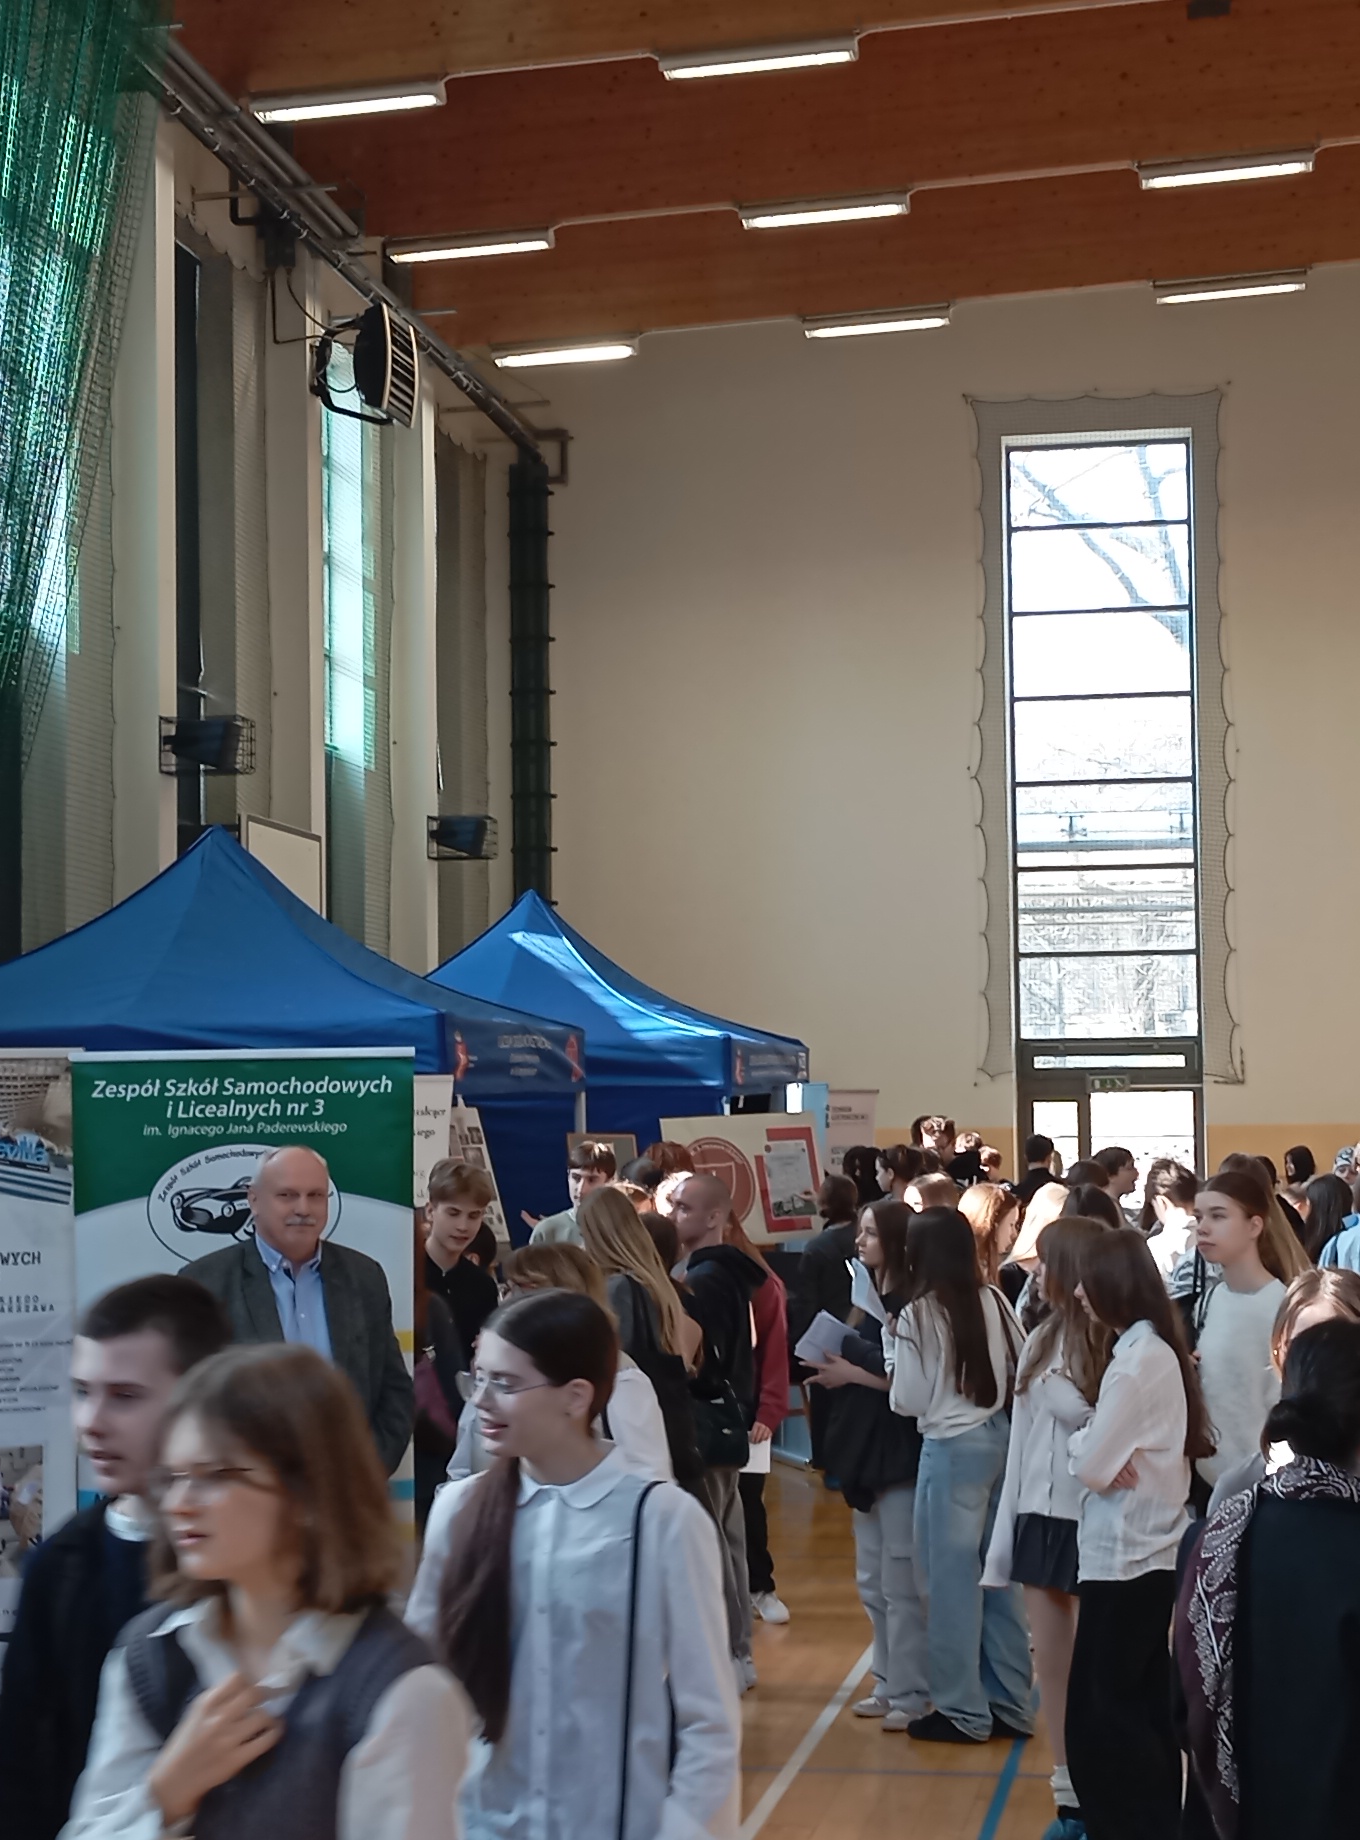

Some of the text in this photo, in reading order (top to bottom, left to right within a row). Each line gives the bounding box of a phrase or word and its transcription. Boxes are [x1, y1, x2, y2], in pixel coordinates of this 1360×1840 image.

[91, 1075, 393, 1102] Zespół Szkół Samochodowych
[166, 1099, 325, 1121] i Licealnych nr 3
[143, 1121, 348, 1139] im. Ignacego Jana Paderewskiego
